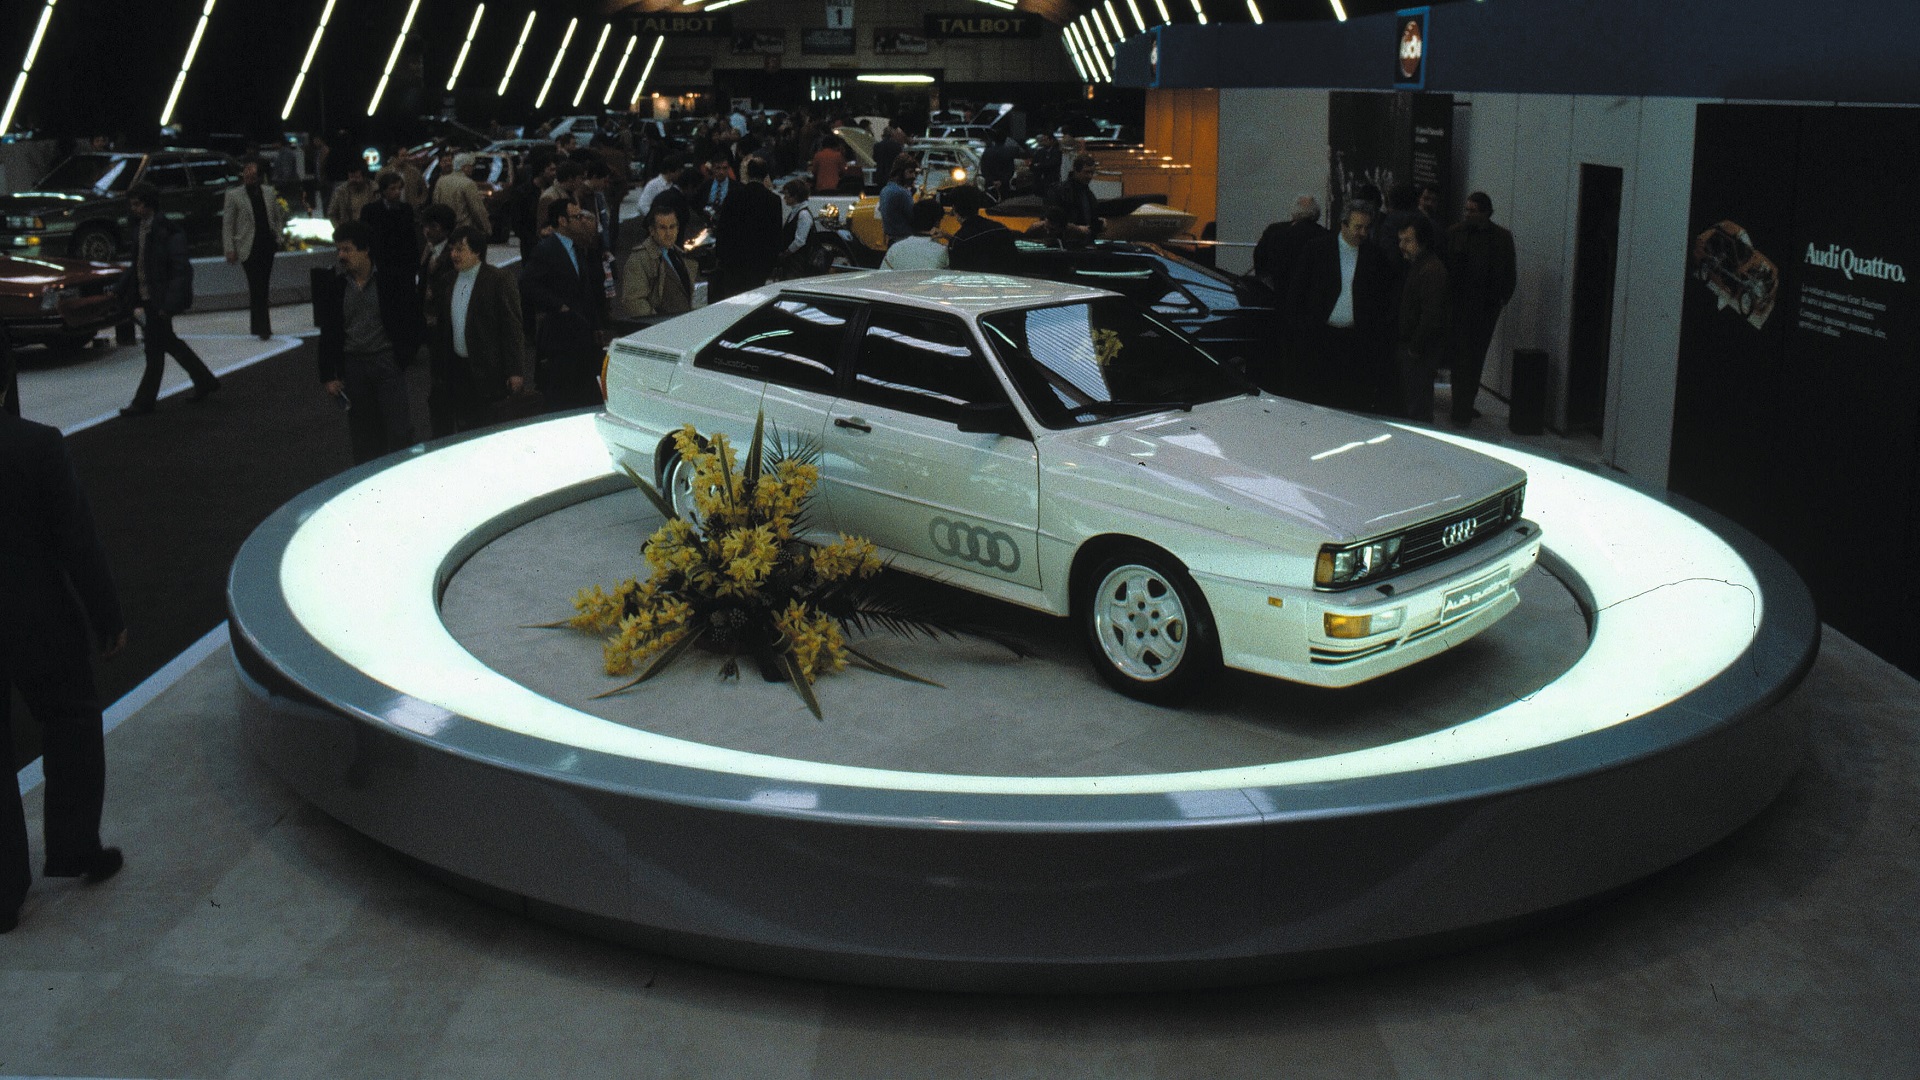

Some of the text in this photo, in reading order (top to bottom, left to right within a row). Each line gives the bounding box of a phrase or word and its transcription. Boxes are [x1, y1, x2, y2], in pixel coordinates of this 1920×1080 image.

[628, 17, 717, 32] TALBOT
[836, 9, 844, 26] 1
[937, 18, 1026, 33] TALBOT
[1804, 242, 1840, 269] Audi
[714, 357, 758, 372] quattro
